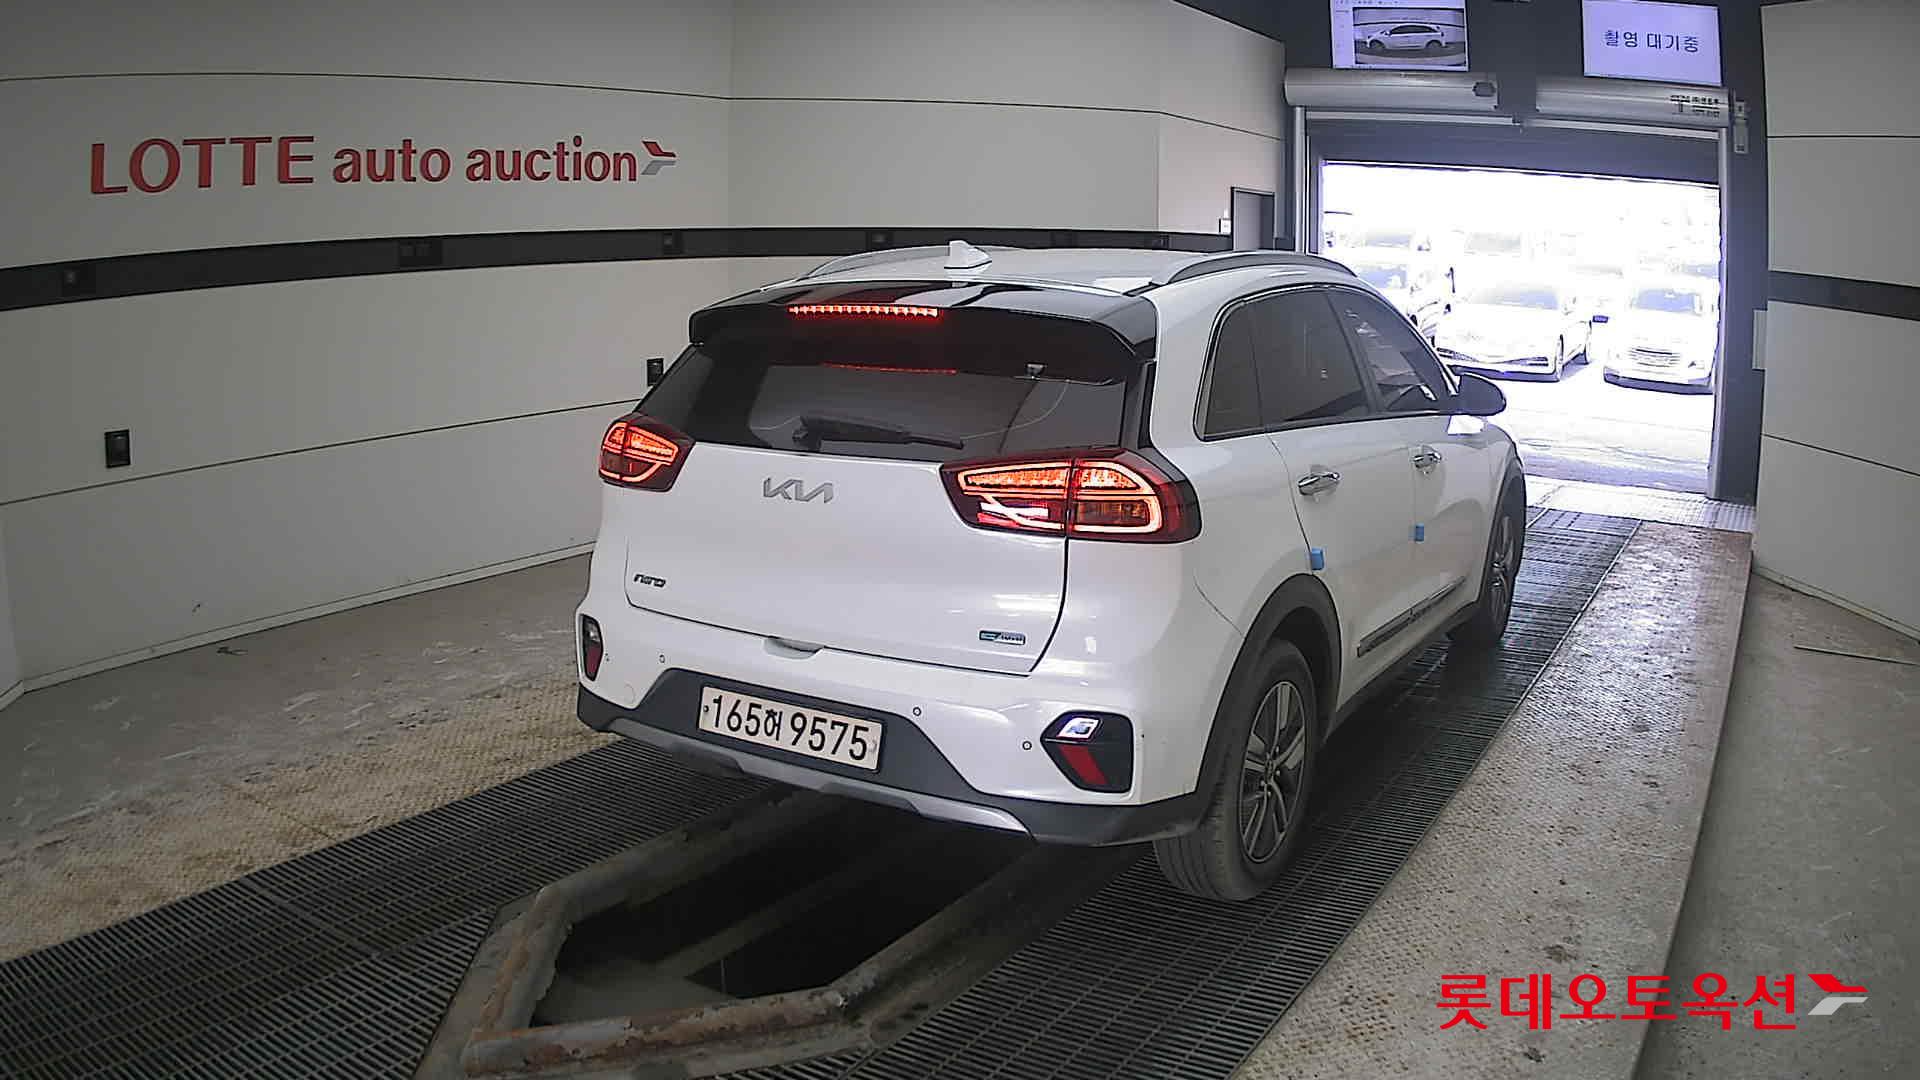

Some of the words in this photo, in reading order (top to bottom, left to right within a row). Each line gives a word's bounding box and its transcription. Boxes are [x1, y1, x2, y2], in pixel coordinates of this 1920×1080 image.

[1646, 33, 1699, 53] 대기중
[91, 136, 314, 194] LOTTE
[334, 139, 451, 183] auto
[465, 135, 638, 182] auction
[763, 477, 833, 503] KIA
